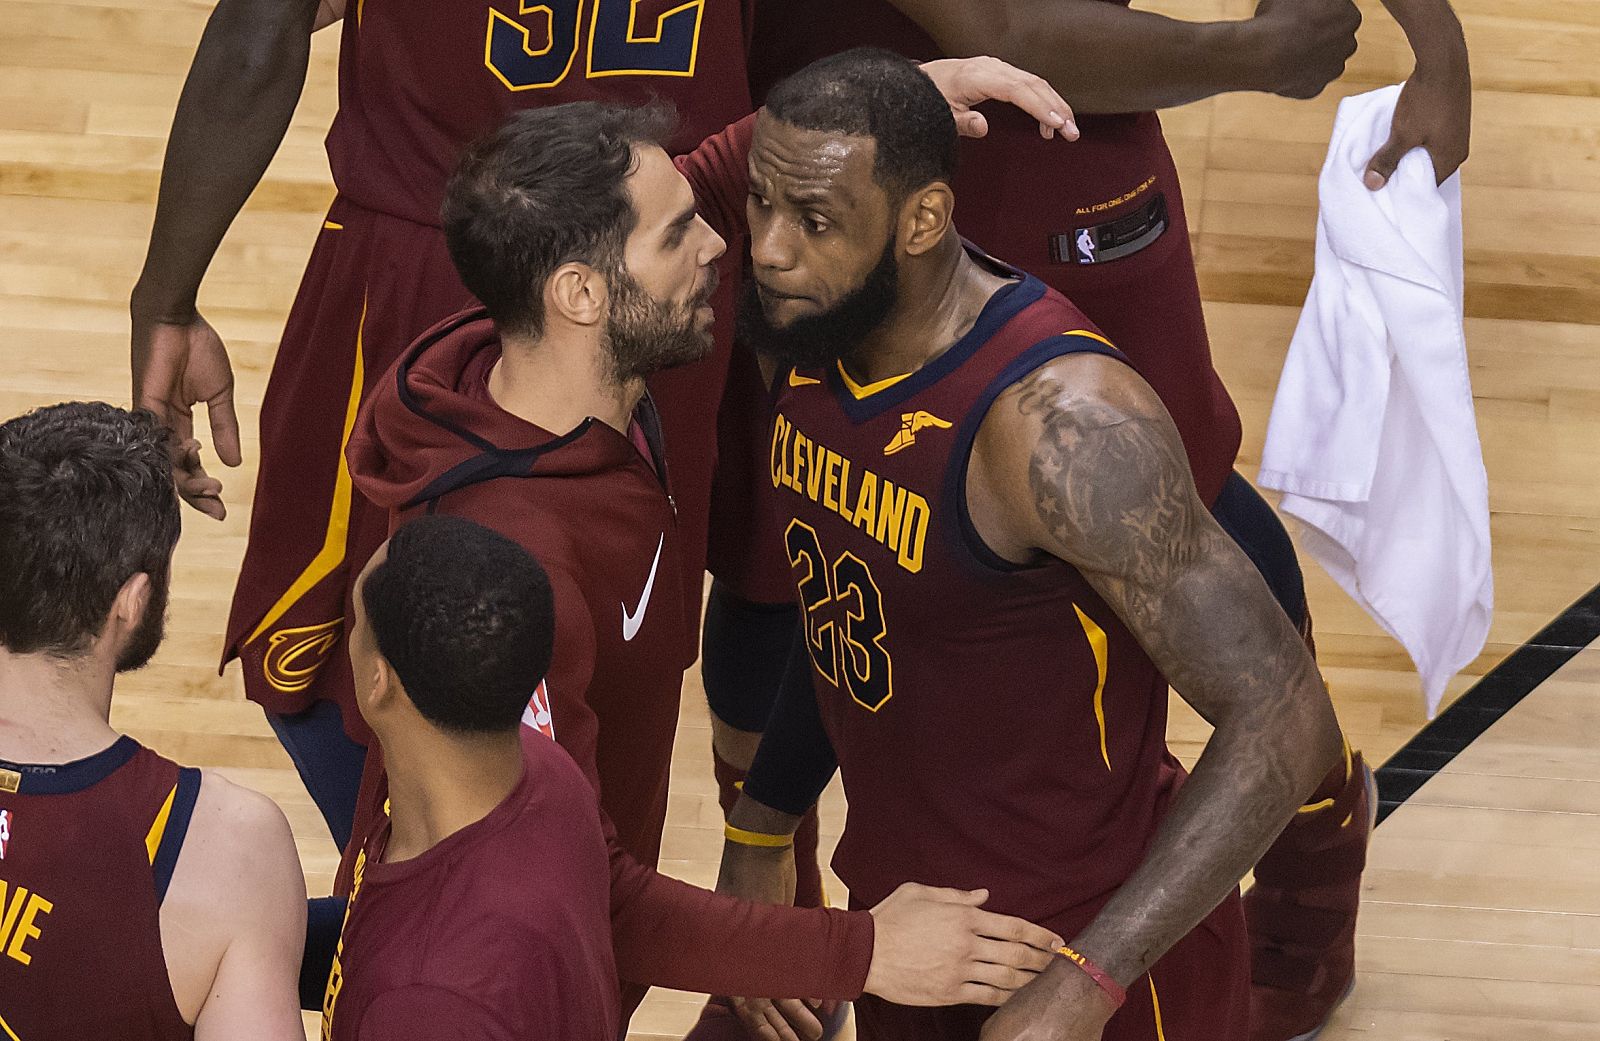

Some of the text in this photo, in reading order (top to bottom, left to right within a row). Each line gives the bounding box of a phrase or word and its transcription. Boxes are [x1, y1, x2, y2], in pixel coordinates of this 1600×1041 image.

[1092, 202, 1109, 212] FOR
[771, 413, 930, 574] CLEVELAND
[784, 518, 893, 712] 23
